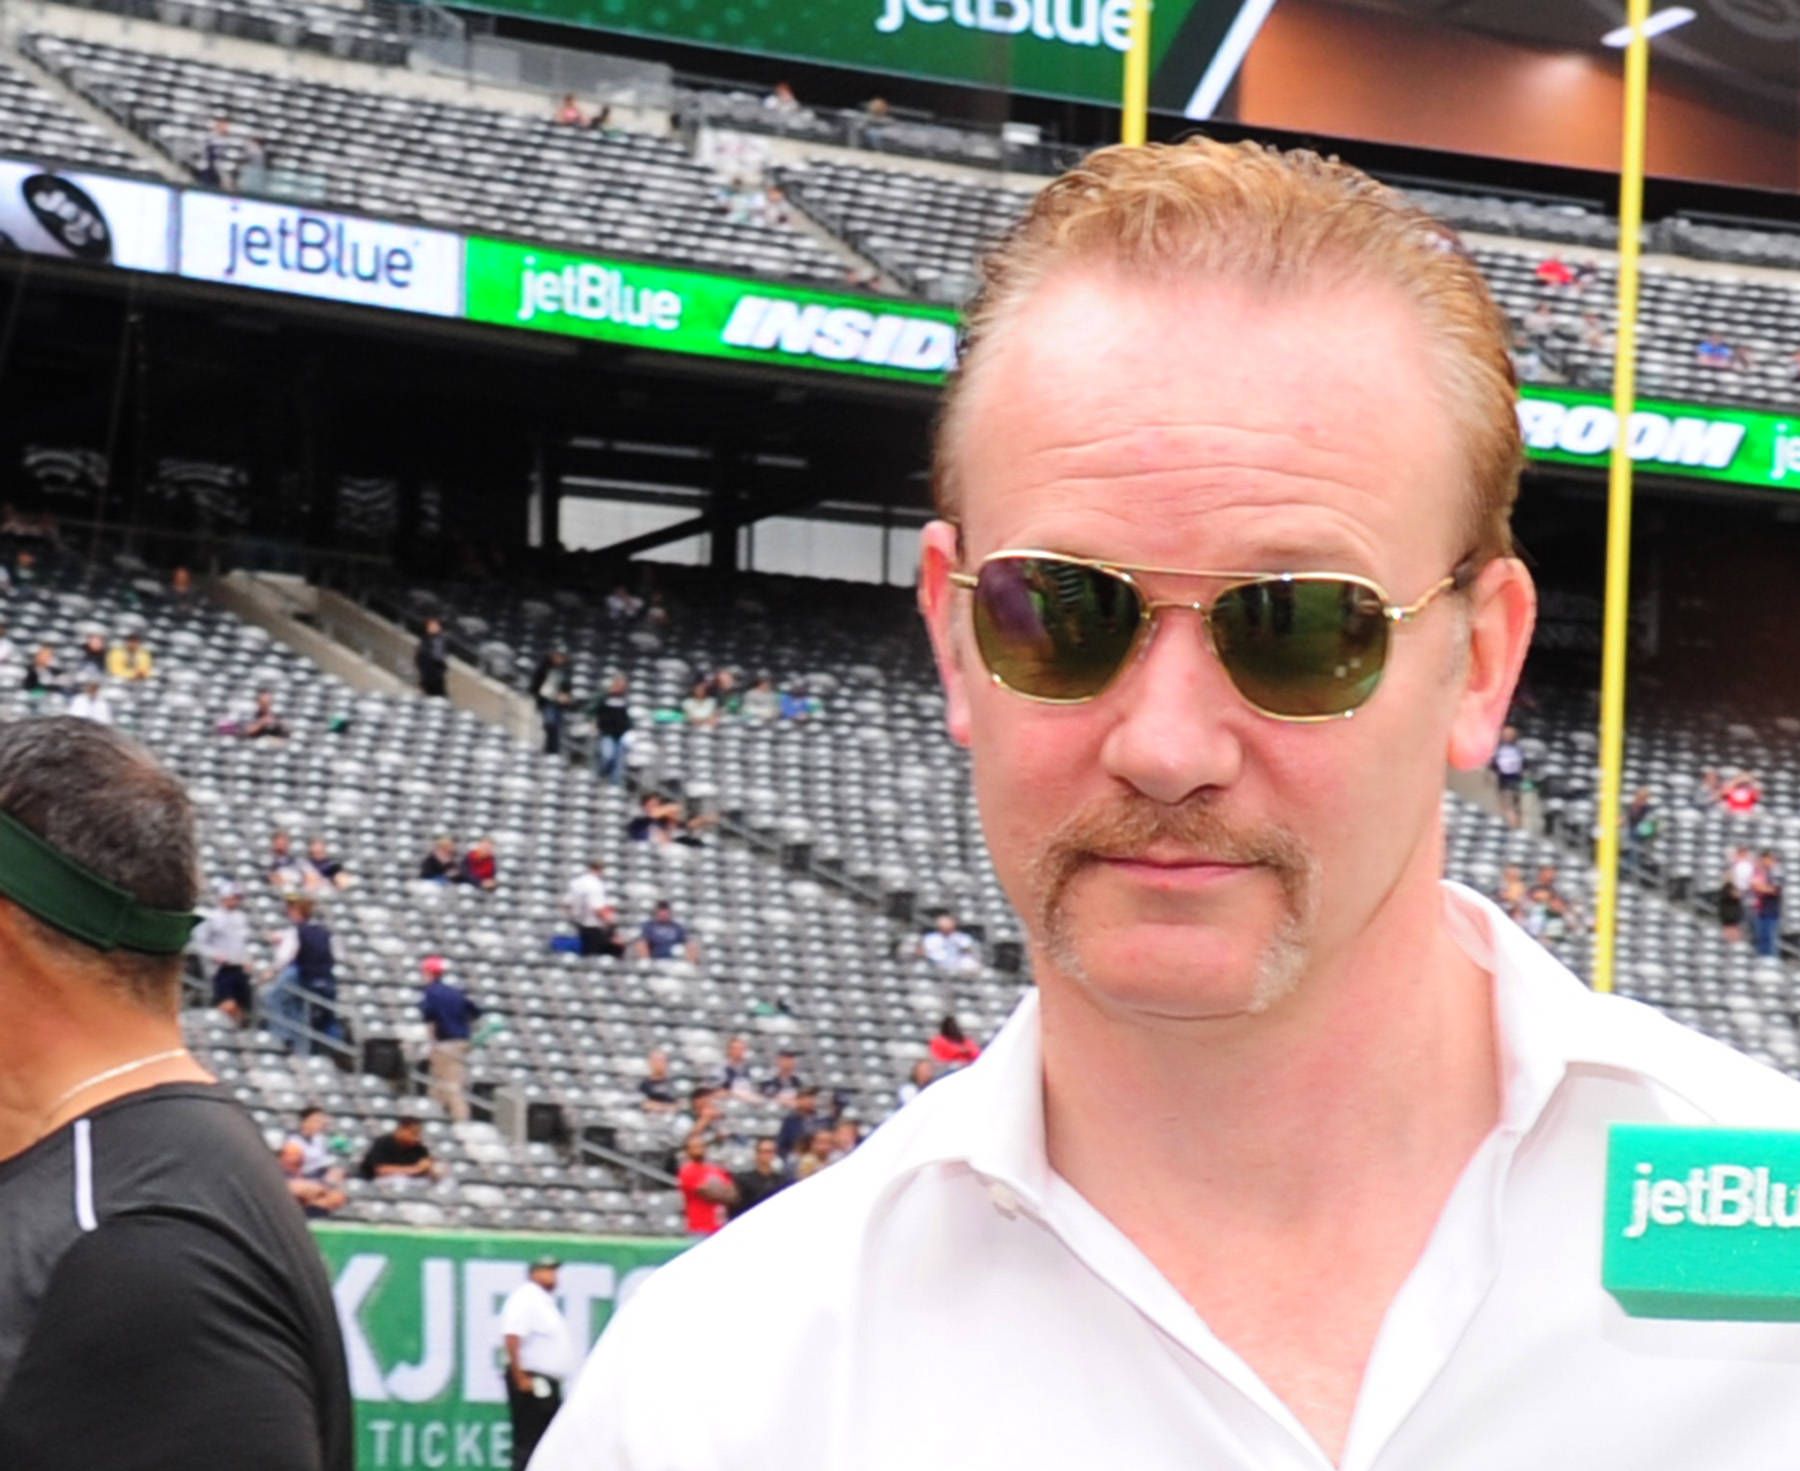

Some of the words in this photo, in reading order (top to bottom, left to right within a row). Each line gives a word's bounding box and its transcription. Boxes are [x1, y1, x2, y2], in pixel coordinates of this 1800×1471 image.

[224, 204, 413, 288] jetBlue
[517, 255, 684, 331] jetBlue
[722, 295, 958, 371] INSID
[367, 1418, 514, 1469] TICKE
